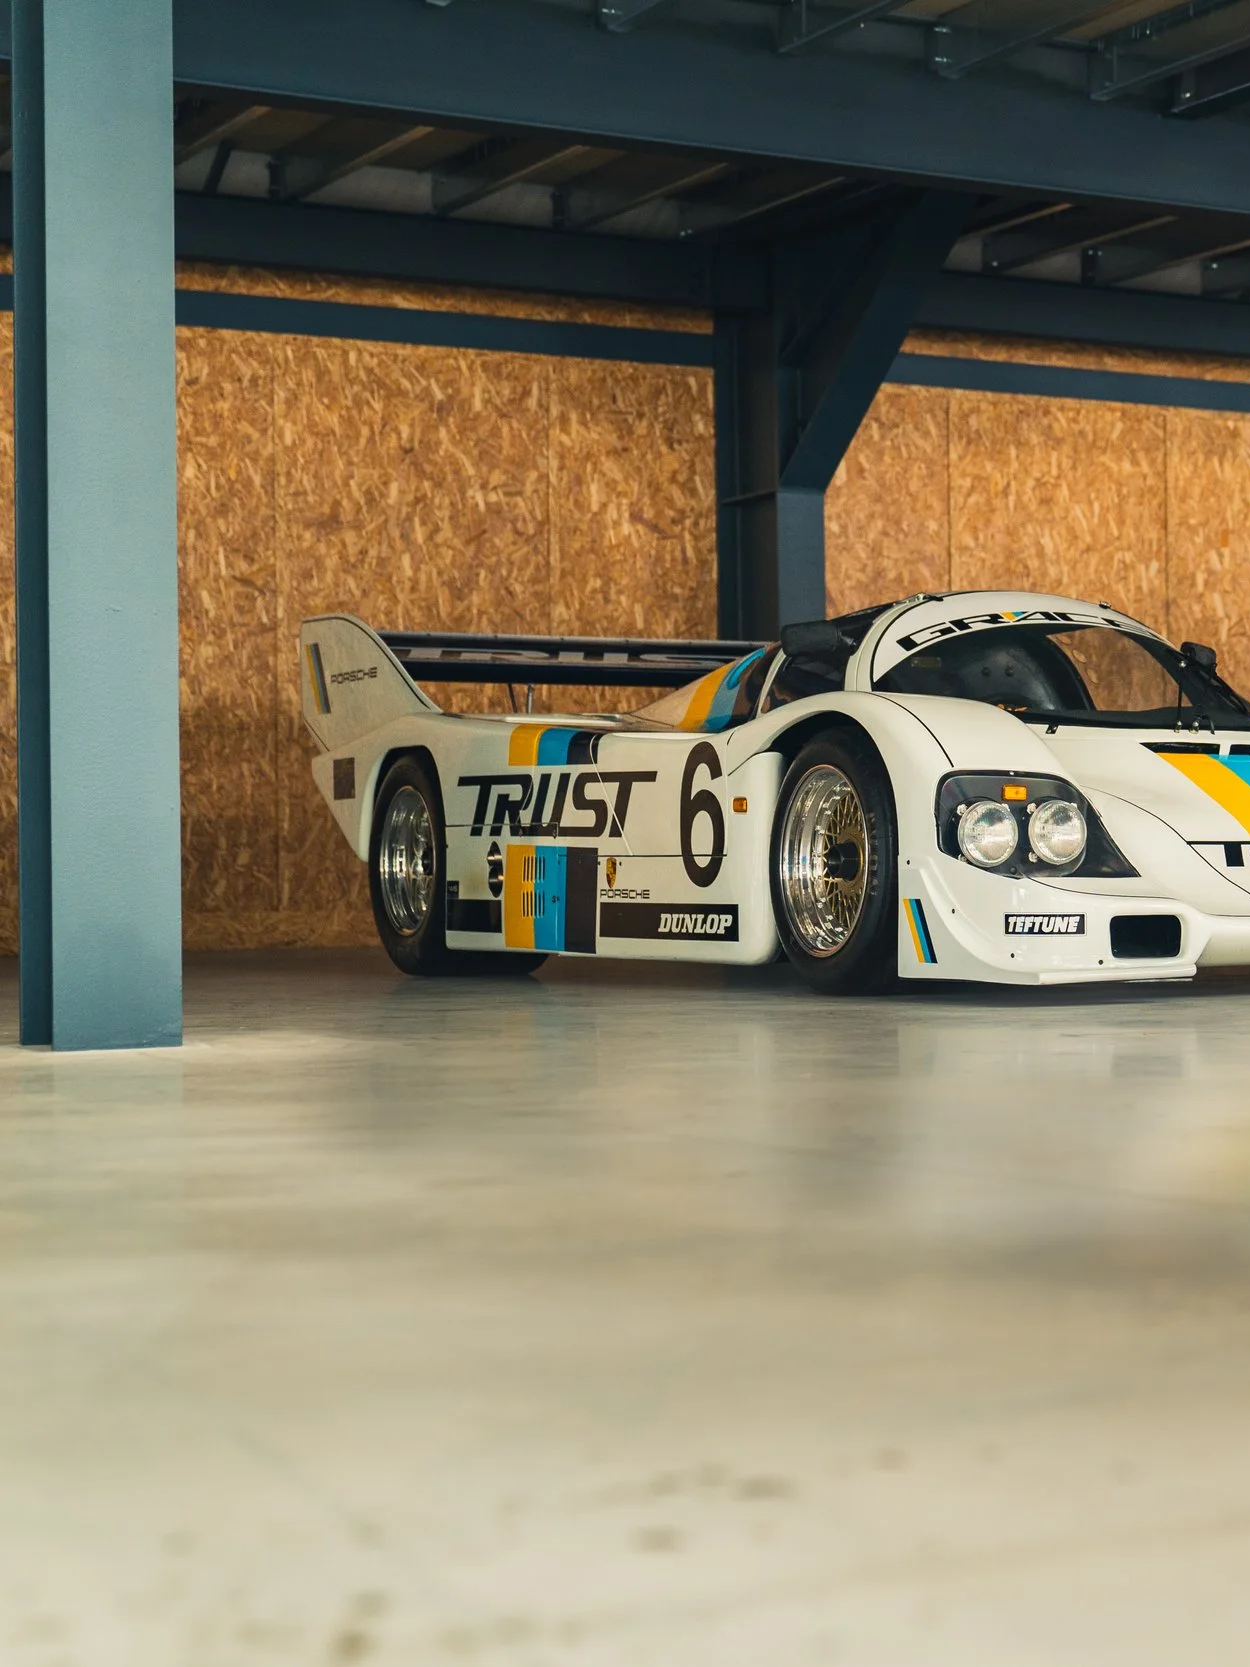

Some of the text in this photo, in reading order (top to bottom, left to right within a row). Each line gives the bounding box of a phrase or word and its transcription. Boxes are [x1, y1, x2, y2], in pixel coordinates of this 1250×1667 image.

[391, 646, 740, 670] TRUS
[331, 667, 378, 684] PORSCHE
[457, 770, 658, 838] TRUST
[681, 741, 726, 888] 6
[599, 889, 650, 900] PORSCHE
[657, 913, 733, 935] DUNLOP
[1007, 916, 1081, 933] TEFTUNE
